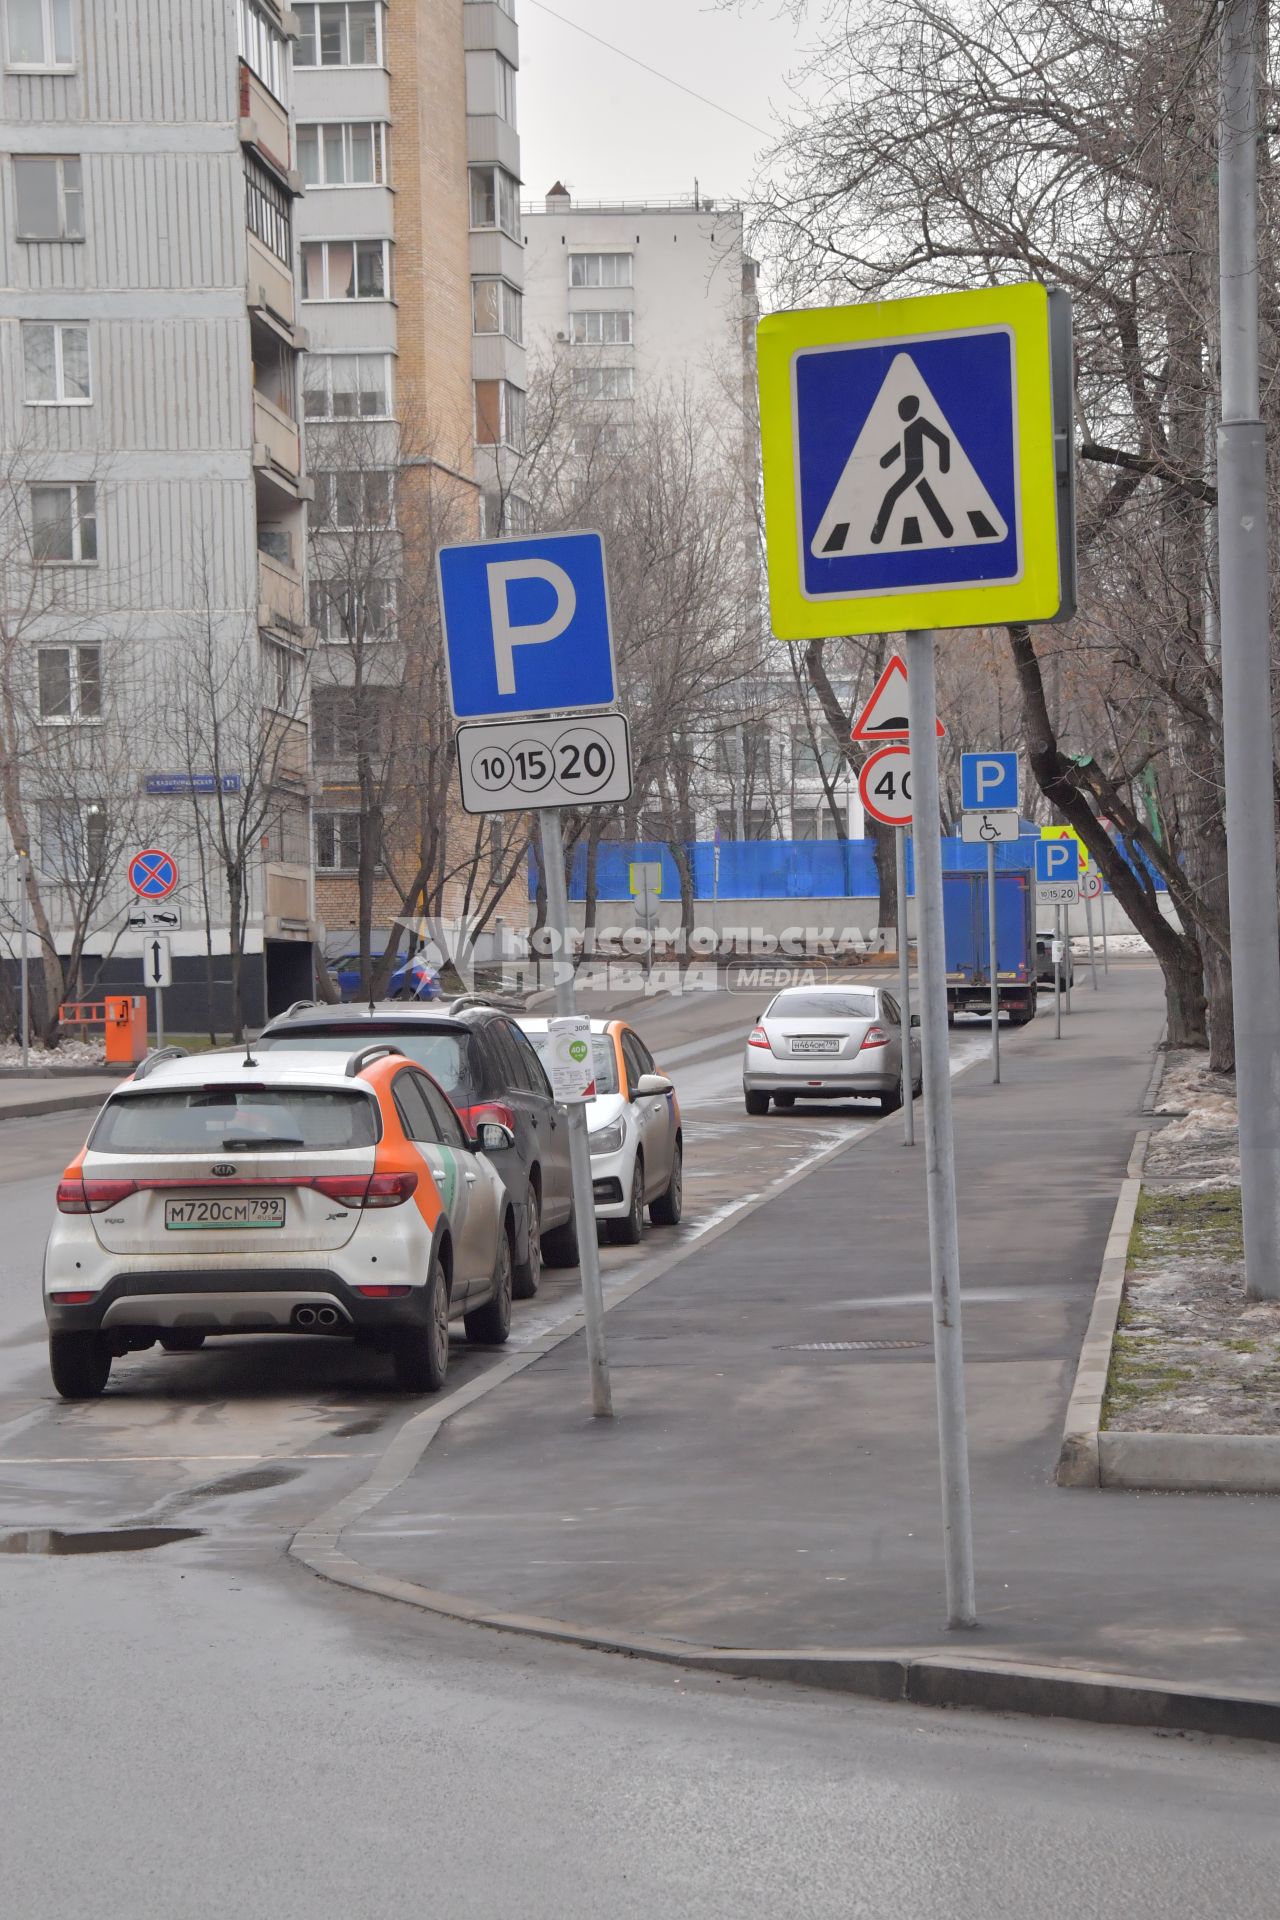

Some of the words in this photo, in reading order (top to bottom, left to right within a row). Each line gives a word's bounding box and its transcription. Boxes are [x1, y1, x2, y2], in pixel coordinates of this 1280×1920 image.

[486, 558, 577, 695] P
[480, 757, 505, 780] 10
[515, 751, 546, 781] 15
[559, 742, 606, 779] 20
[976, 760, 1006, 802] P
[1046, 845, 1069, 877] P
[1049, 890, 1058, 898] 15
[1061, 889, 1073, 898] 20
[215, 1166, 234, 1175] KIA
[171, 1202, 247, 1222] М720СМ
[250, 1200, 279, 1215] 799
